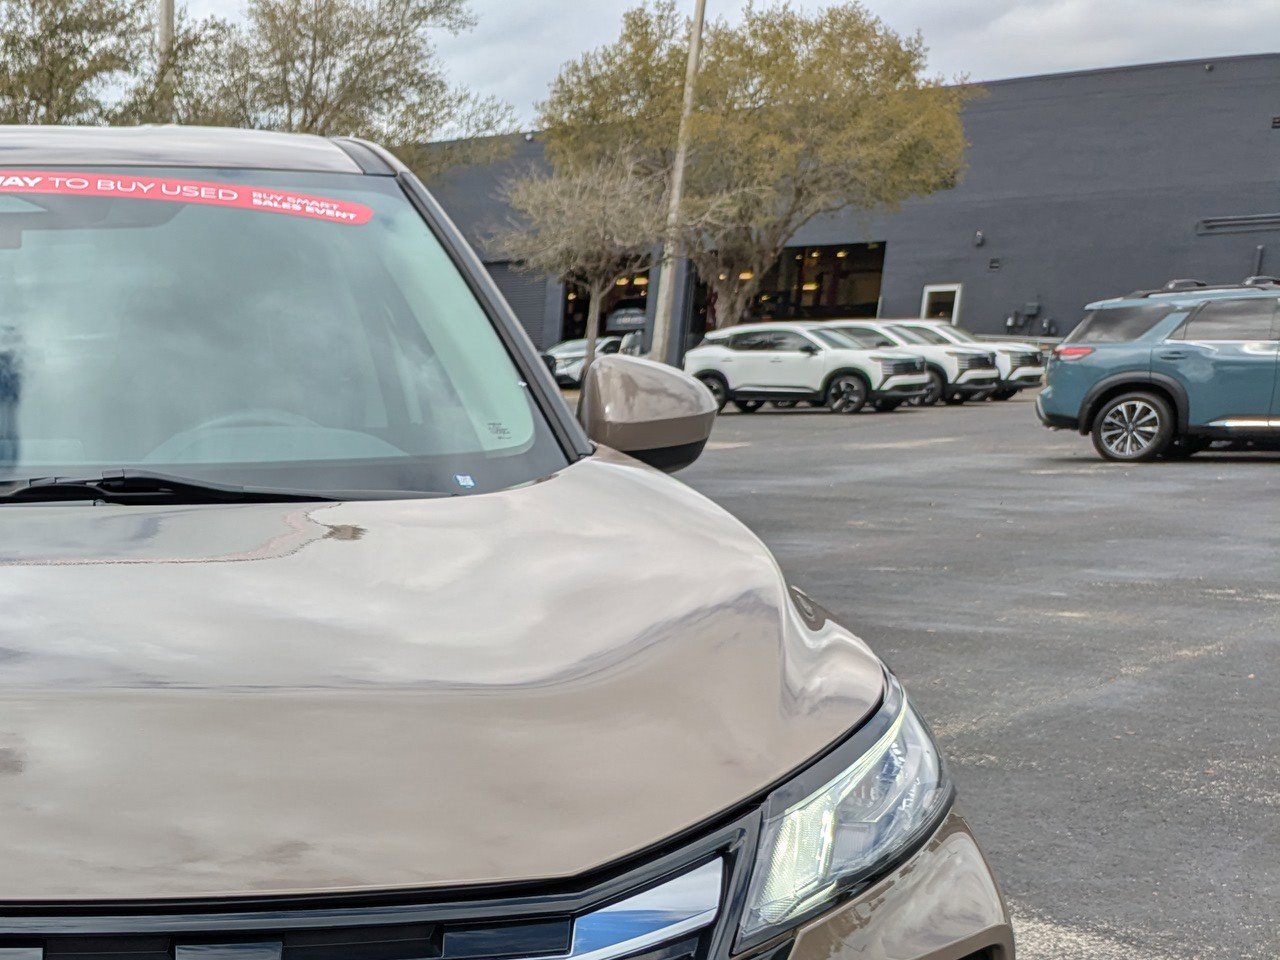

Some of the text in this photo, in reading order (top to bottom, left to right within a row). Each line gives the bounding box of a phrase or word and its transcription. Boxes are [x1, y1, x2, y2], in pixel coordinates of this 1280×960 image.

[48, 177, 90, 190] TO
[96, 179, 156, 194] BUY
[160, 185, 239, 201] USED
[252, 191, 340, 210] BUY SMART
[252, 198, 357, 220] SALES EVENT
